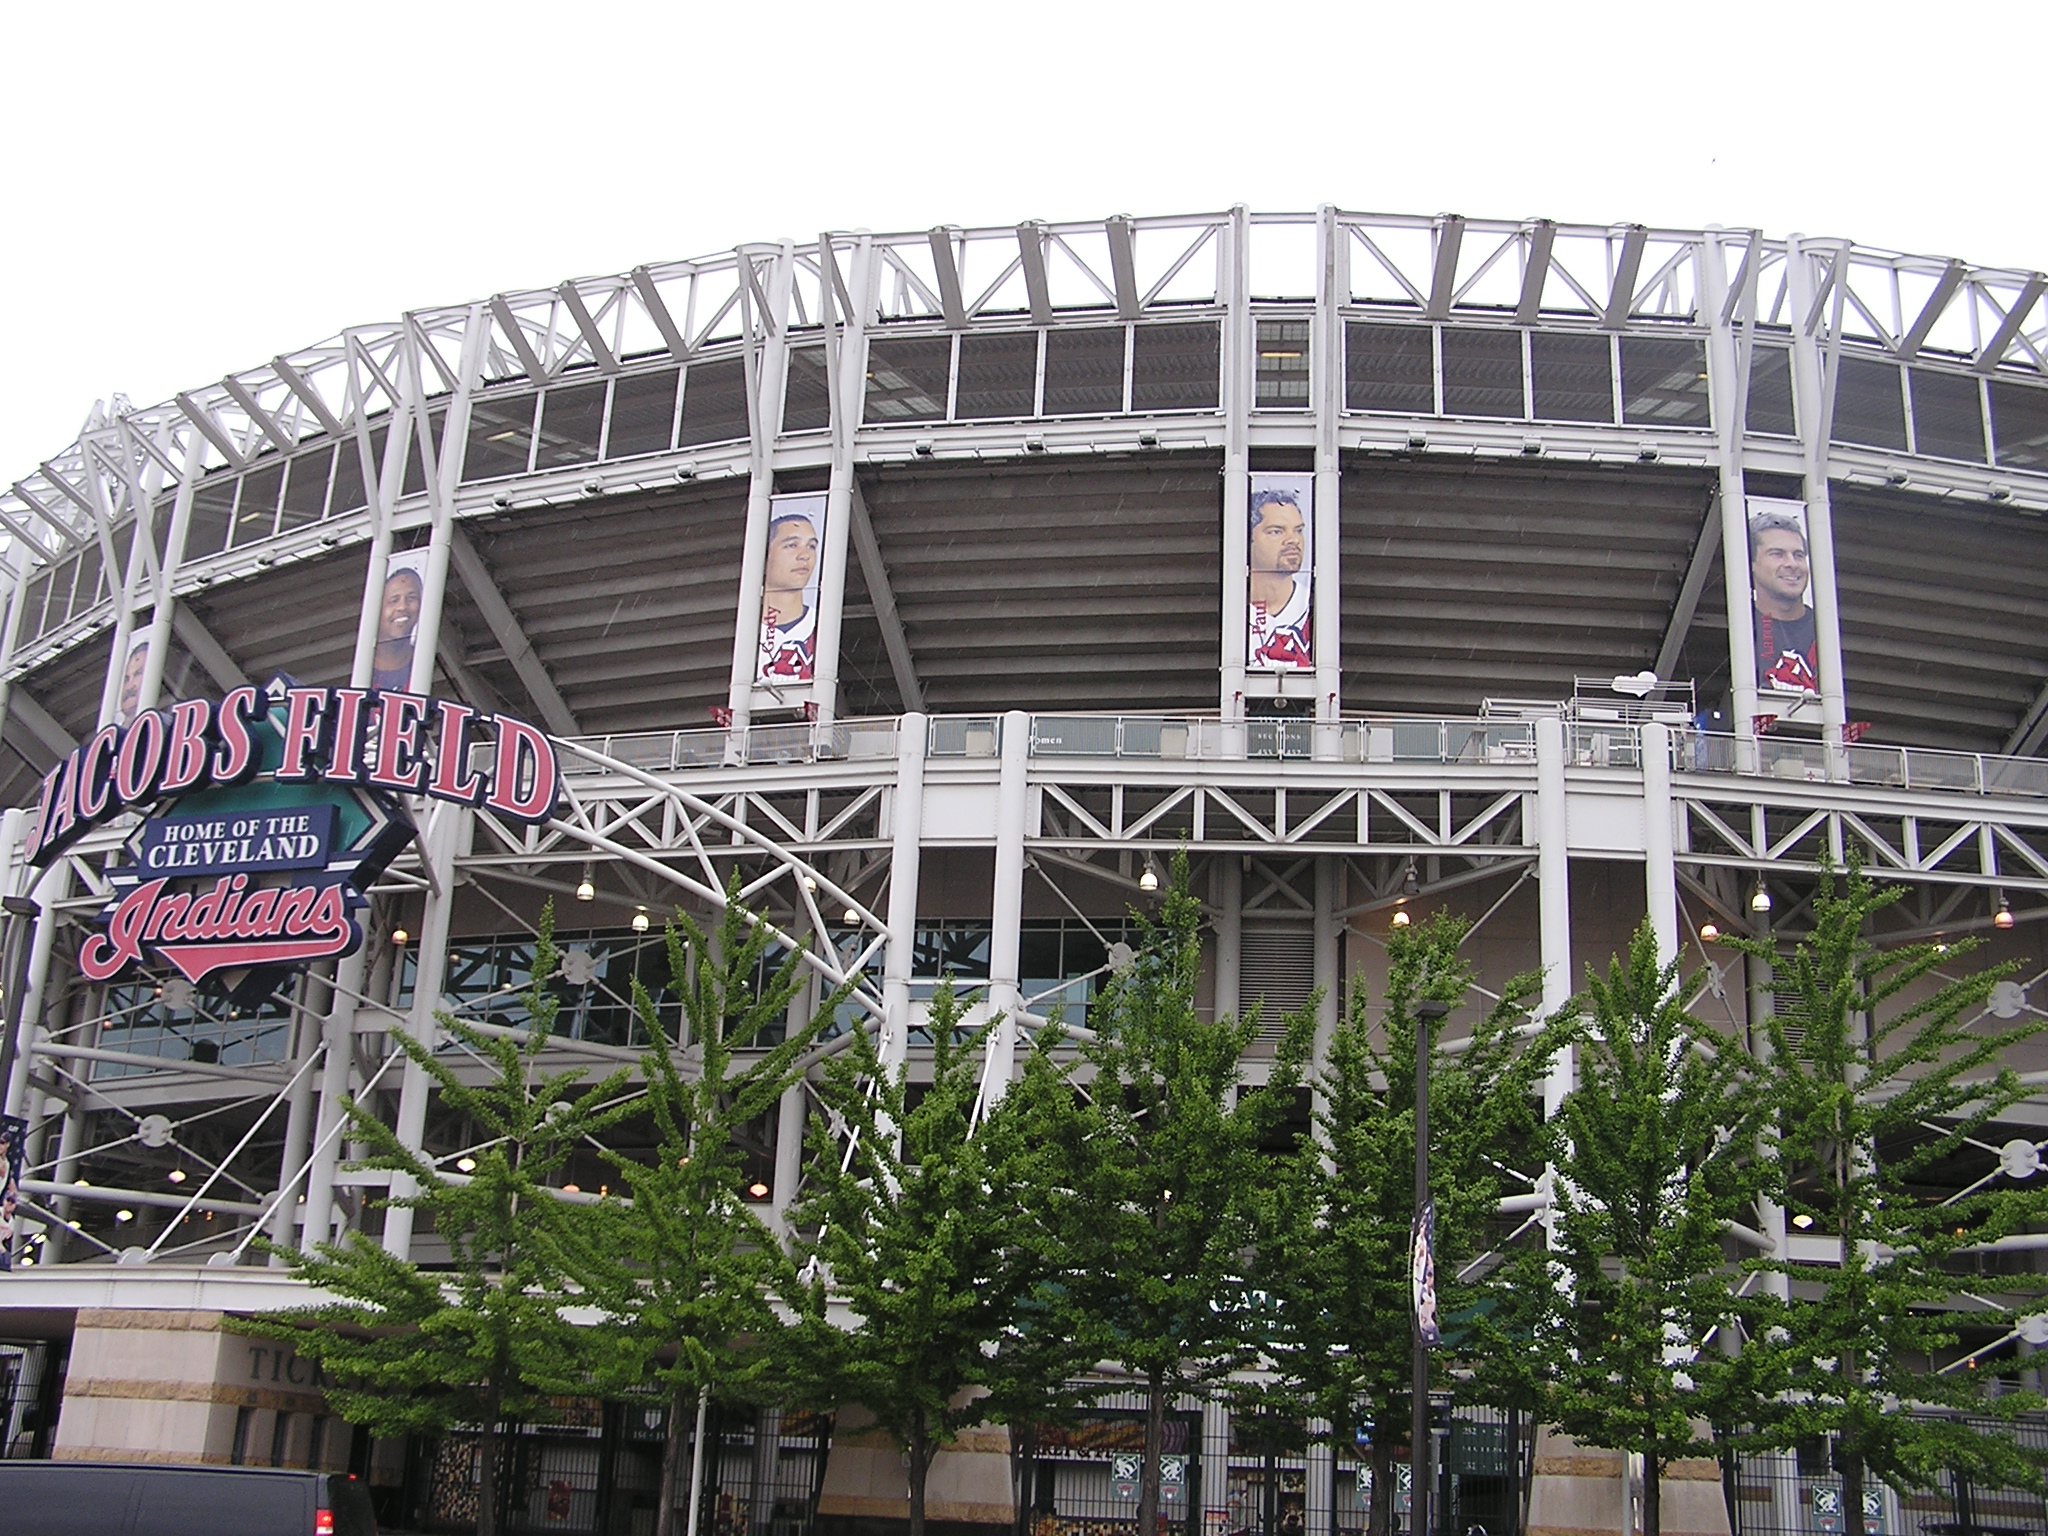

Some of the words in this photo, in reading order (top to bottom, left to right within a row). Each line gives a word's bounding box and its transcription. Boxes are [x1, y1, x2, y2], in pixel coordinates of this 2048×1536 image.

[761, 605, 782, 654] Grady
[1252, 599, 1268, 636] Paul
[1257, 732, 1302, 741] SECONS
[25, 685, 258, 864] JACOBS
[275, 687, 560, 821] FIELD
[164, 820, 228, 842] HOME
[232, 819, 260, 839] OF
[267, 814, 310, 835] THE
[147, 833, 321, 870] CLEVELAND
[79, 872, 352, 983] Indians
[1209, 1289, 1288, 1313] GAT
